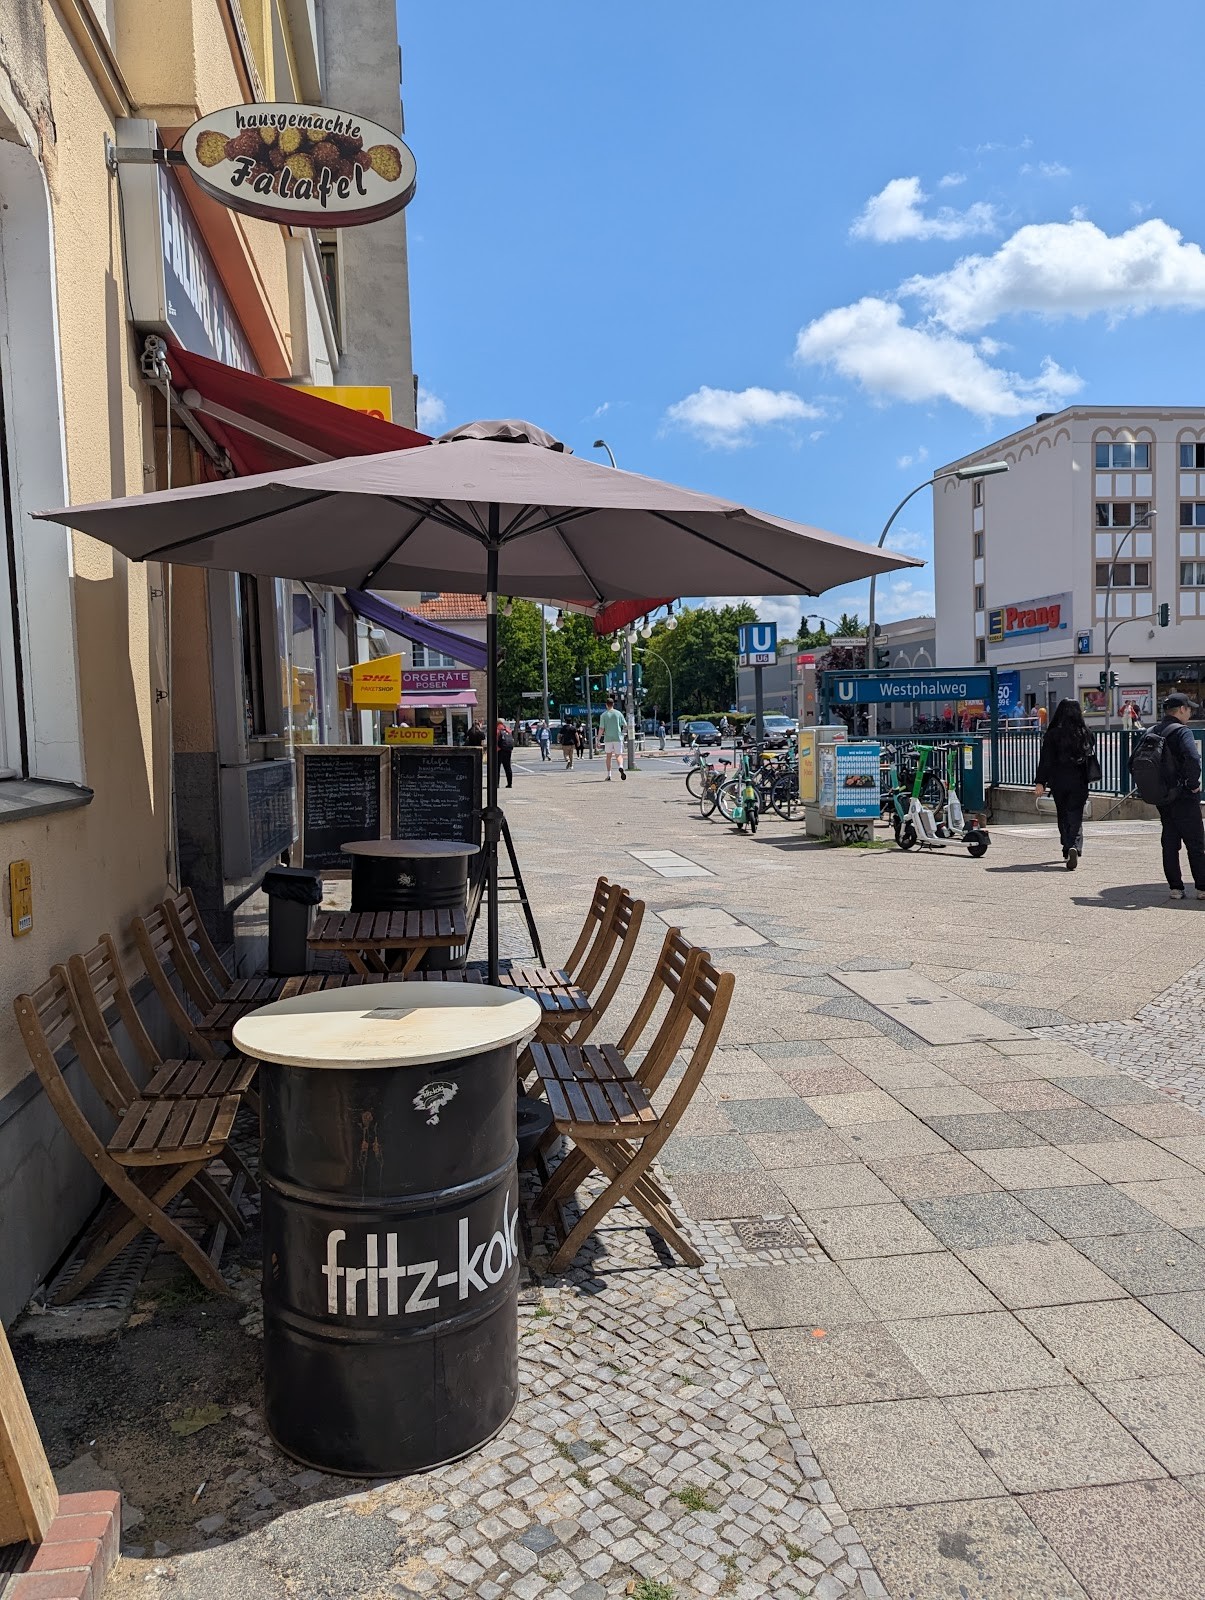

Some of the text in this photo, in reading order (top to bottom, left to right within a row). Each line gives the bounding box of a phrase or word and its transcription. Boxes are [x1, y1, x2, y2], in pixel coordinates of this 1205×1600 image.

[235, 110, 361, 138] hausgemachte
[230, 156, 367, 209] Falafel
[1006, 604, 1061, 631] Prang
[739, 628, 746, 652] U
[752, 627, 771, 651] U
[1083, 639, 1088, 647] P
[757, 654, 768, 662] U6
[361, 674, 392, 682] DHL
[403, 672, 469, 682] ÖRGERÄTE
[416, 681, 448, 689] POSER
[838, 681, 967, 701] U Westphalweg
[400, 730, 428, 738] LOTTO
